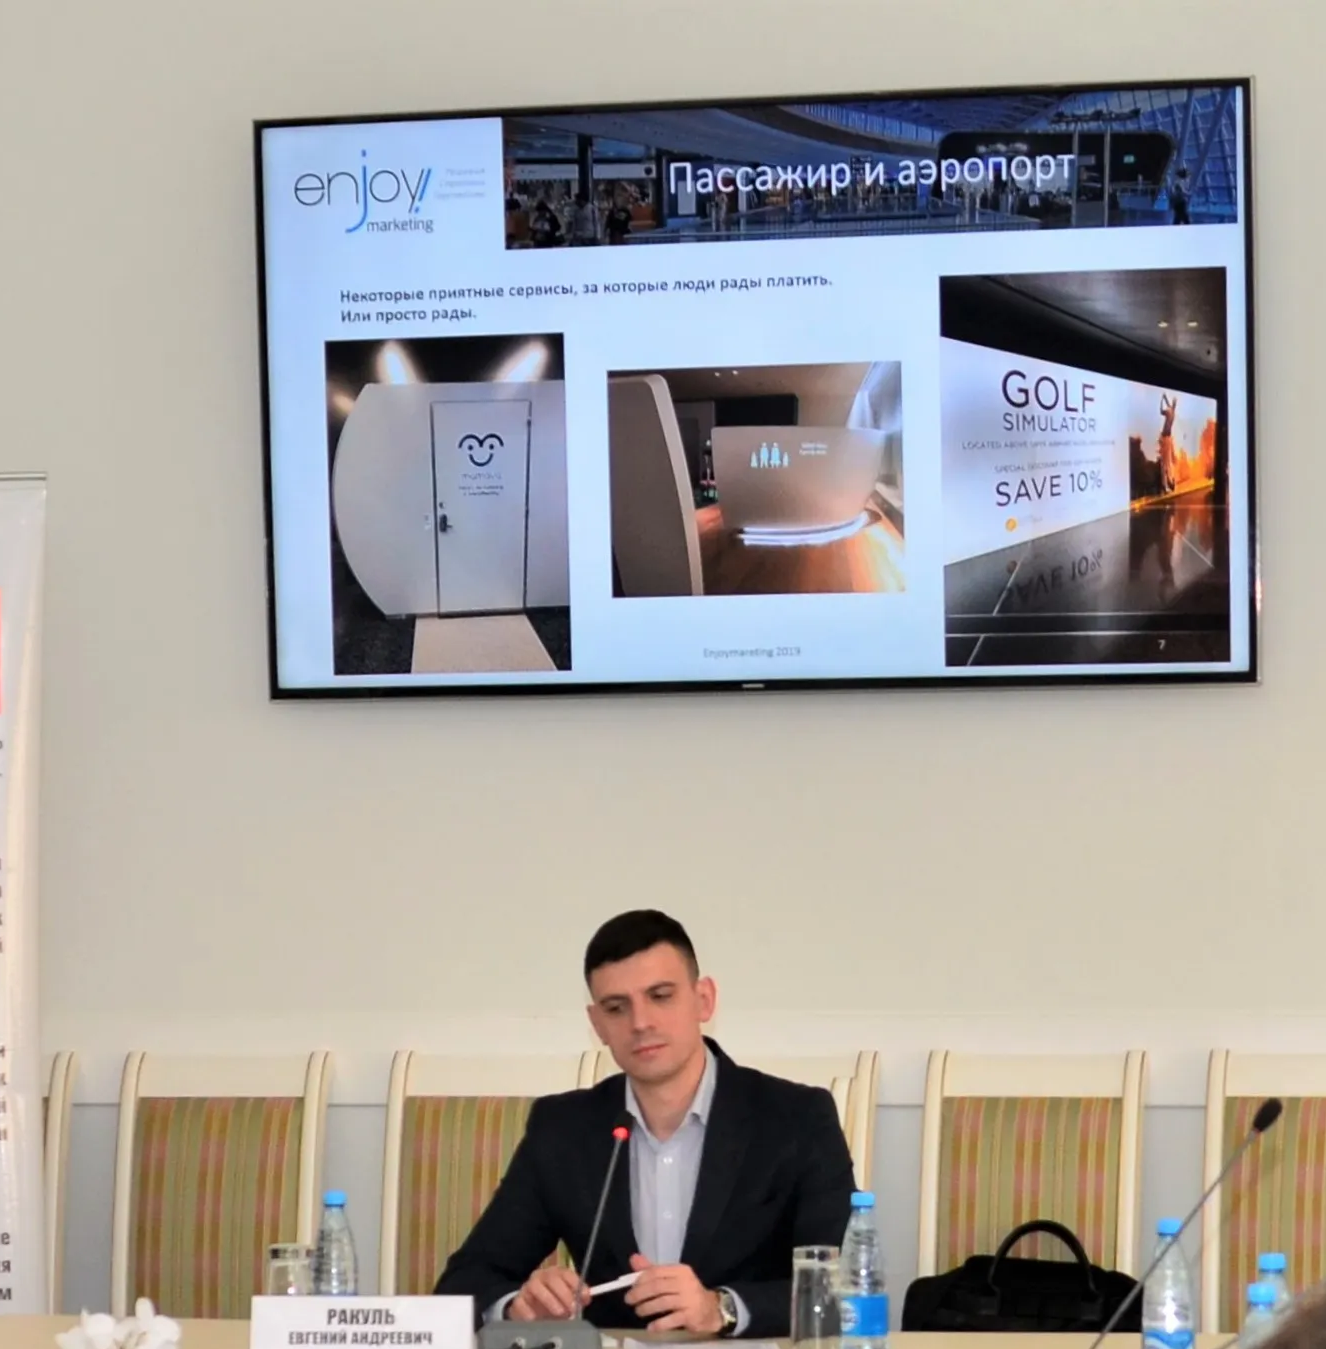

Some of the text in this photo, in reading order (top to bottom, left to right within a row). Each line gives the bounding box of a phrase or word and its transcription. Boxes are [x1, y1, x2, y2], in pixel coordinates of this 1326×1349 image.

[668, 153, 1076, 197] Пассажир и аэропорт
[366, 217, 434, 234] marketing
[340, 275, 833, 304] Некоторые приятные сервисы, за которые люди рады платить.
[340, 308, 477, 324] Или просто рады.
[1001, 369, 1097, 413] GOLF
[1002, 412, 1097, 433] SIMULATOR
[995, 469, 1103, 507] SAVE 10%
[775, 646, 801, 657] 2019
[1157, 639, 1166, 650] 7
[326, 1308, 396, 1326] РАКУЛЬ
[288, 1329, 434, 1346] ЕВГЕНИЙ АНДРЕЕВИЧ
